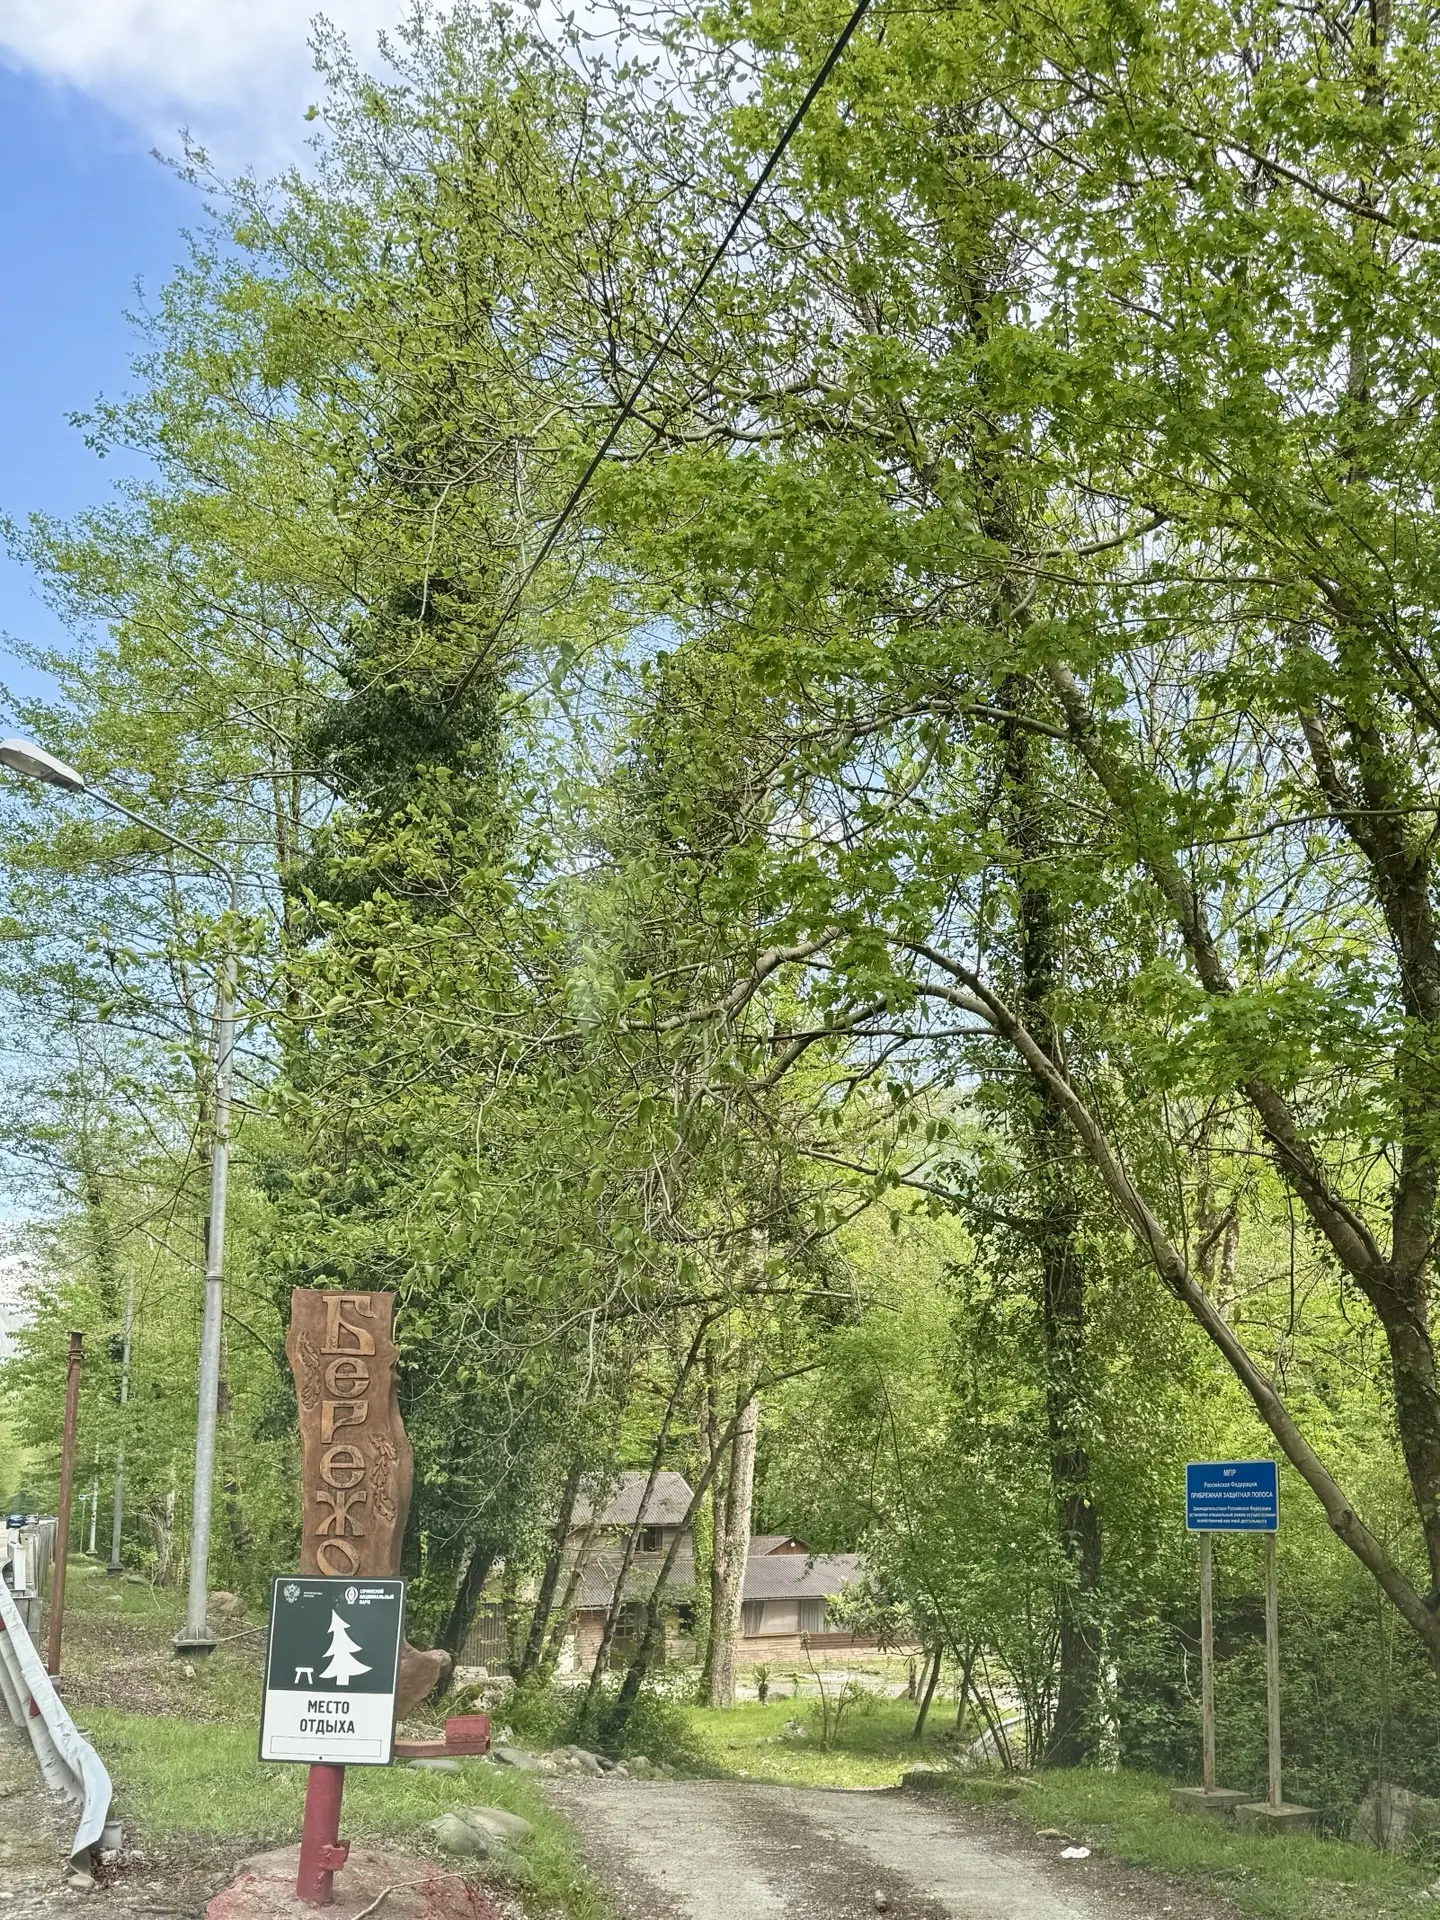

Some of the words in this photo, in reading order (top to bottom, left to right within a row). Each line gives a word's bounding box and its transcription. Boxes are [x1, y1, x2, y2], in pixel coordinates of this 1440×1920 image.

[1223, 1469, 1236, 1477] МПР
[307, 1699, 350, 1715] МЕСТО
[299, 1718, 355, 1735] ОТДЫХА
